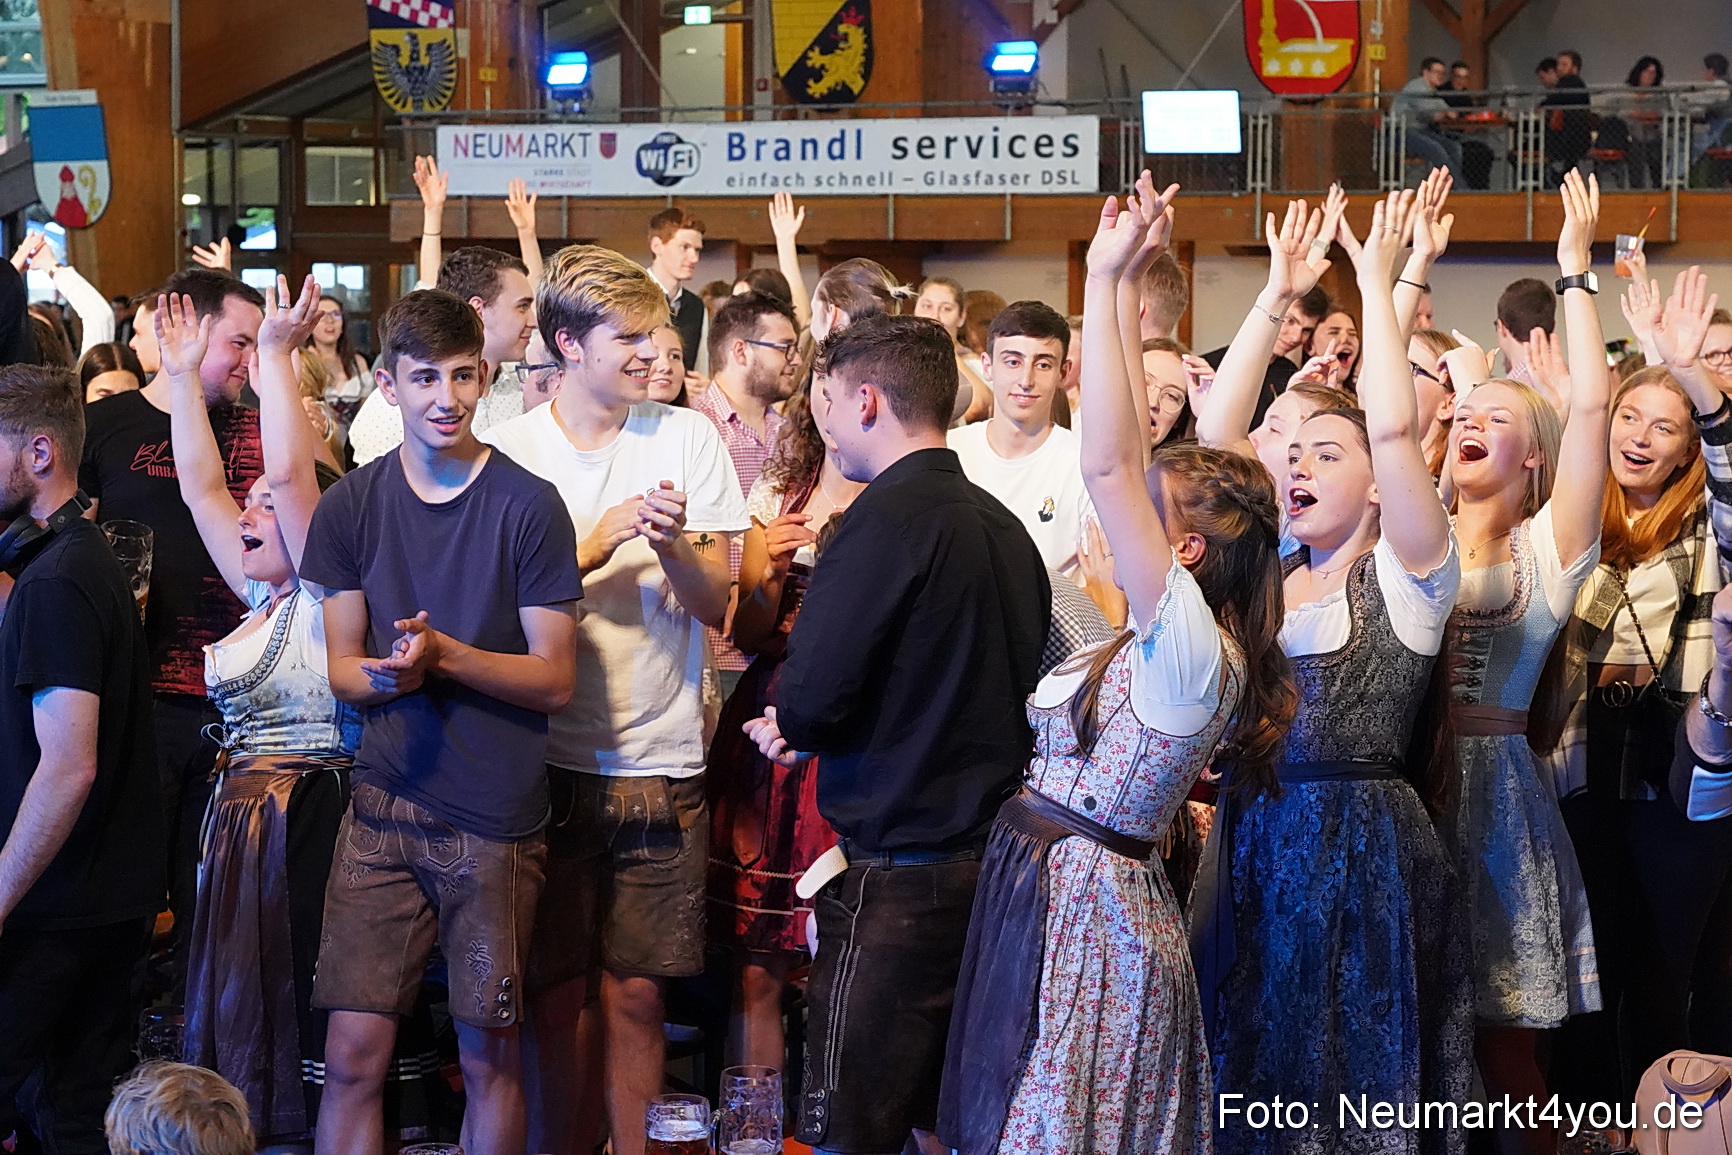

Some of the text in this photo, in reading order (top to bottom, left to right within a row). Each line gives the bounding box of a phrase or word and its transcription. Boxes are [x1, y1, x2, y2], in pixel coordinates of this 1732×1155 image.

[453, 132, 592, 159] NEUMARKT
[726, 126, 1080, 162] Brandl services
[726, 172, 805, 188] einfach
[814, 171, 894, 188] schnell
[923, 170, 1031, 187] Glasfaser
[1041, 169, 1080, 186] DSL
